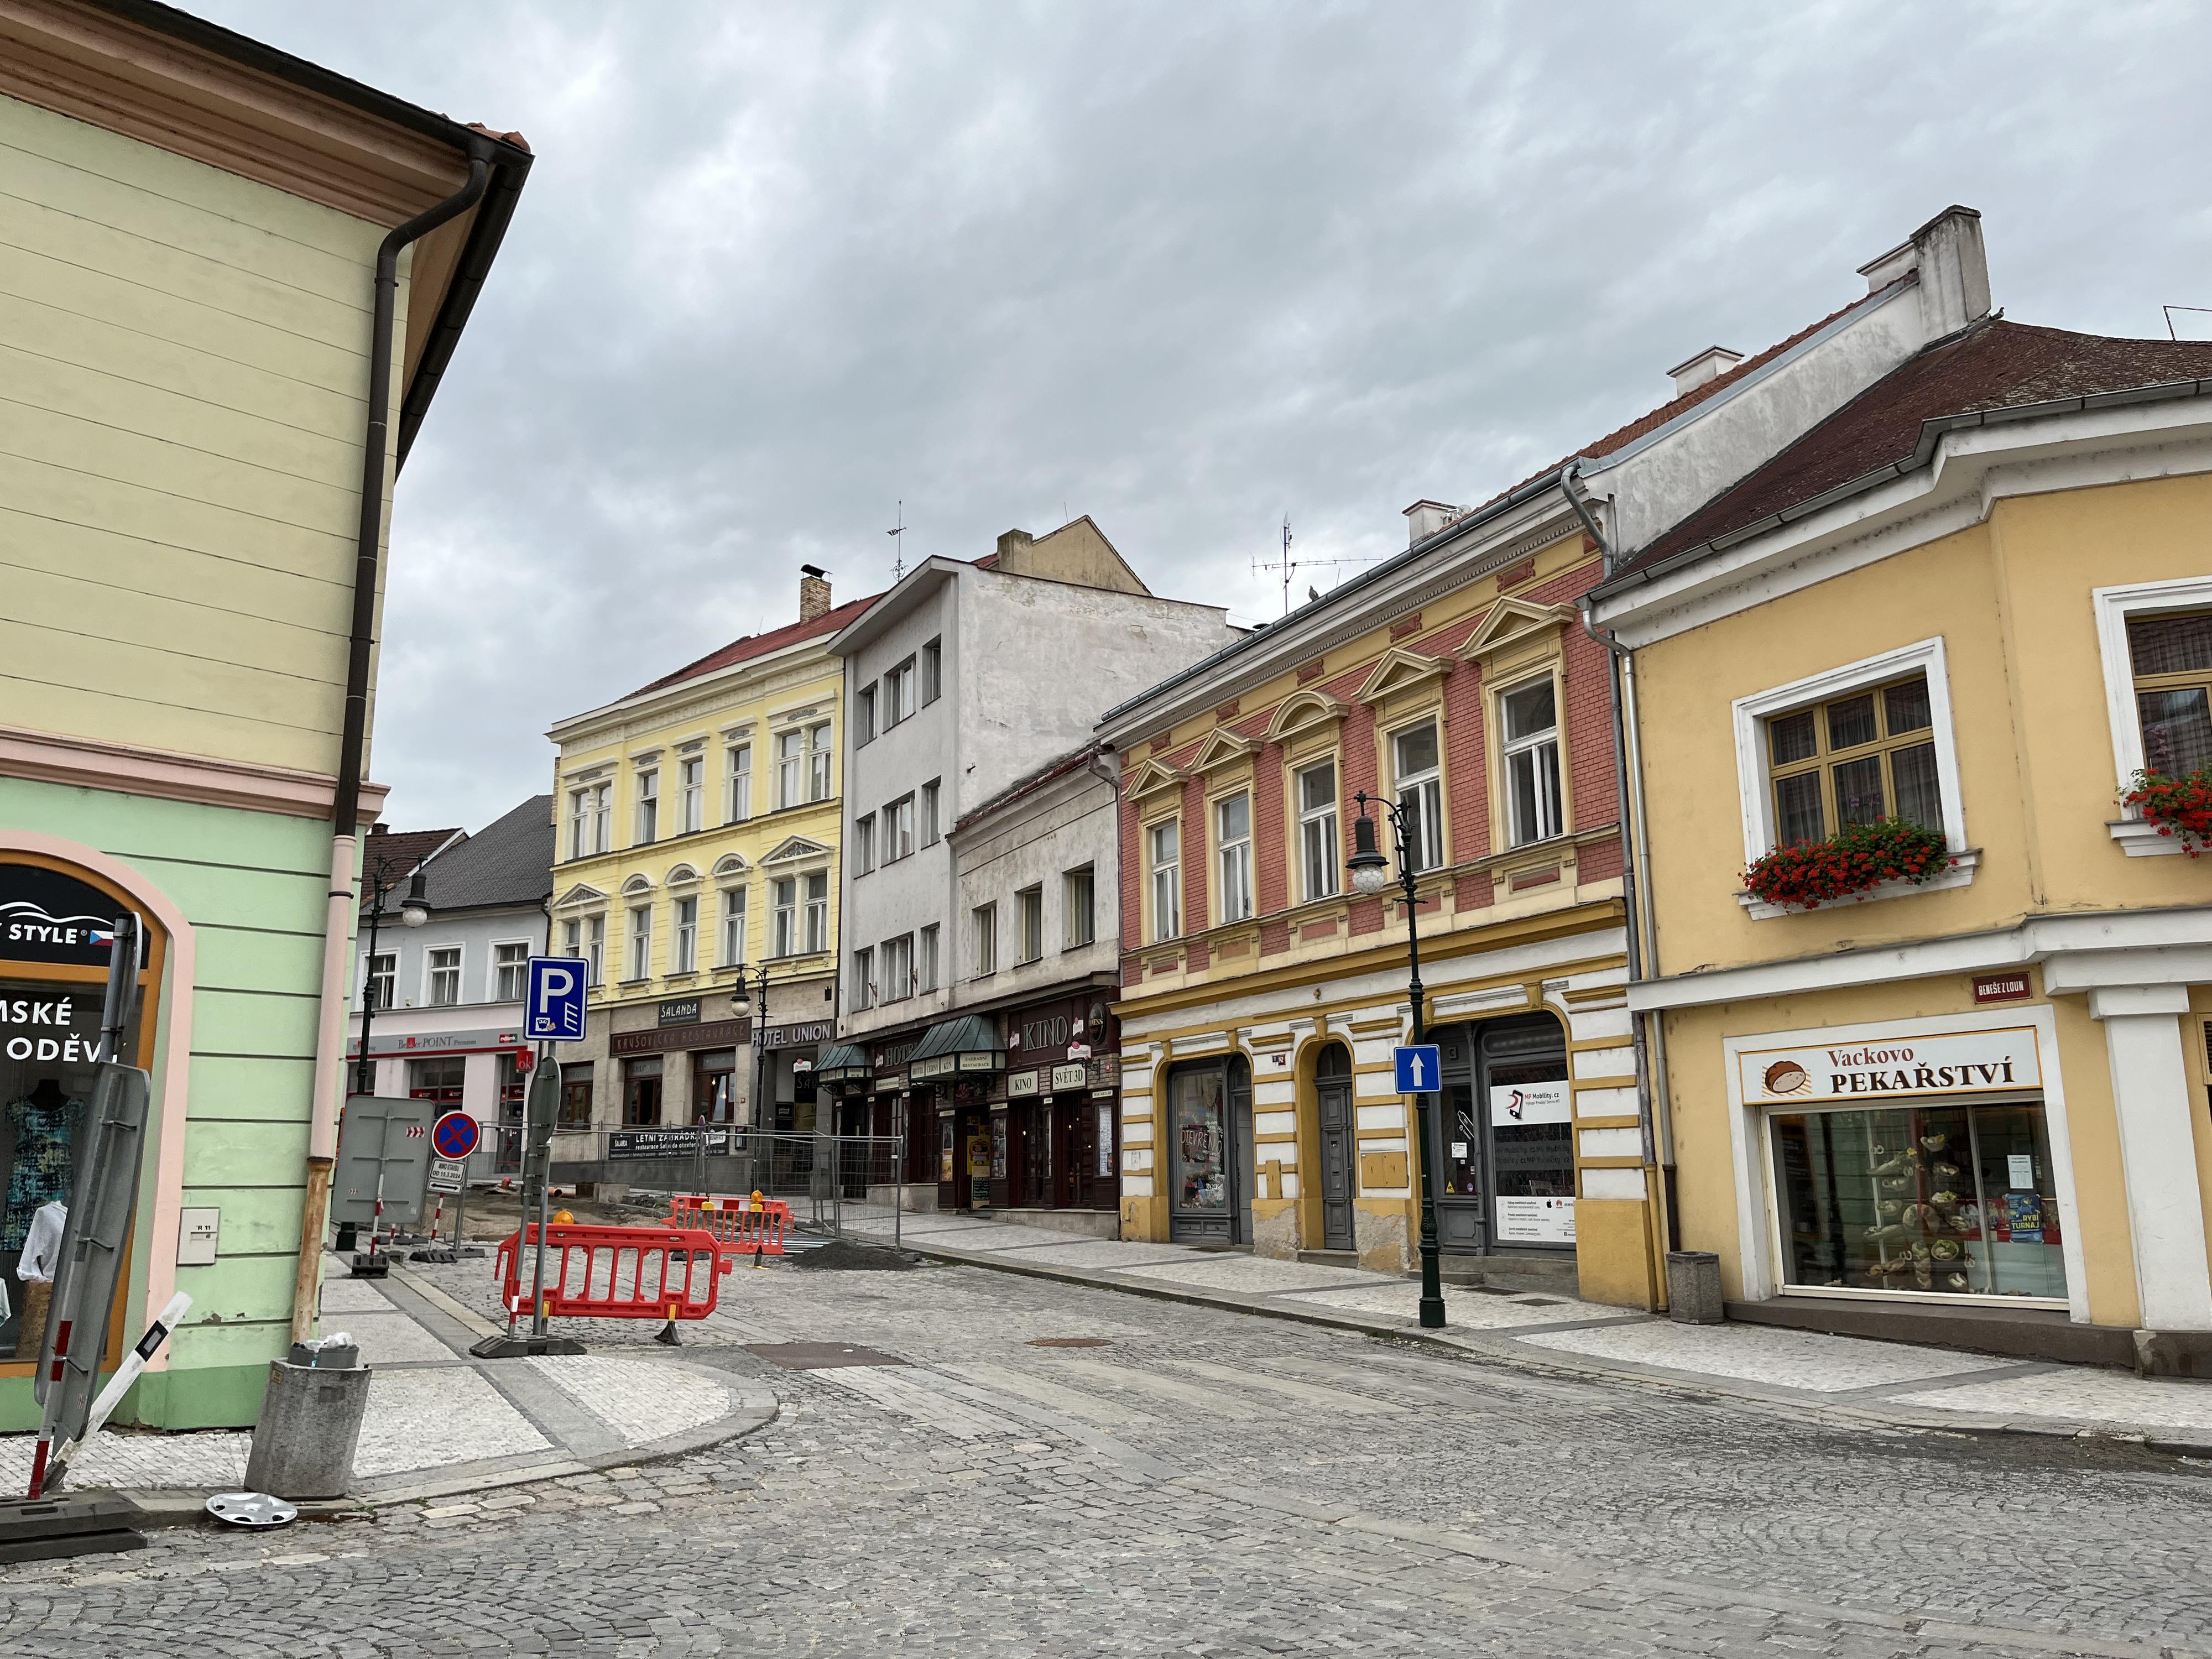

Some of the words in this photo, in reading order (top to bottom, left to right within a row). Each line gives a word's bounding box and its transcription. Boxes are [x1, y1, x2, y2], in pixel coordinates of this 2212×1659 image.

[9, 924, 77, 945] STYLE
[540, 968, 573, 1013] P
[1979, 982, 2001, 995] BENEŠE
[2001, 983, 2006, 993] Z
[2006, 981, 2024, 993] LOUN
[661, 1003, 697, 1018] ŠALANDA
[423, 1036, 453, 1048] POINT
[792, 1024, 831, 1043] UNION
[1023, 1016, 1067, 1052] KINO
[1827, 1047, 1914, 1067] Vackovo
[1055, 1068, 1073, 1084] SVĚT
[1074, 1070, 1083, 1082] 3D
[1830, 1056, 2015, 1093] PEKAŘSTVÍ
[1015, 1078, 1031, 1091] KINO
[2022, 1213, 2039, 1222] RYBÍ
